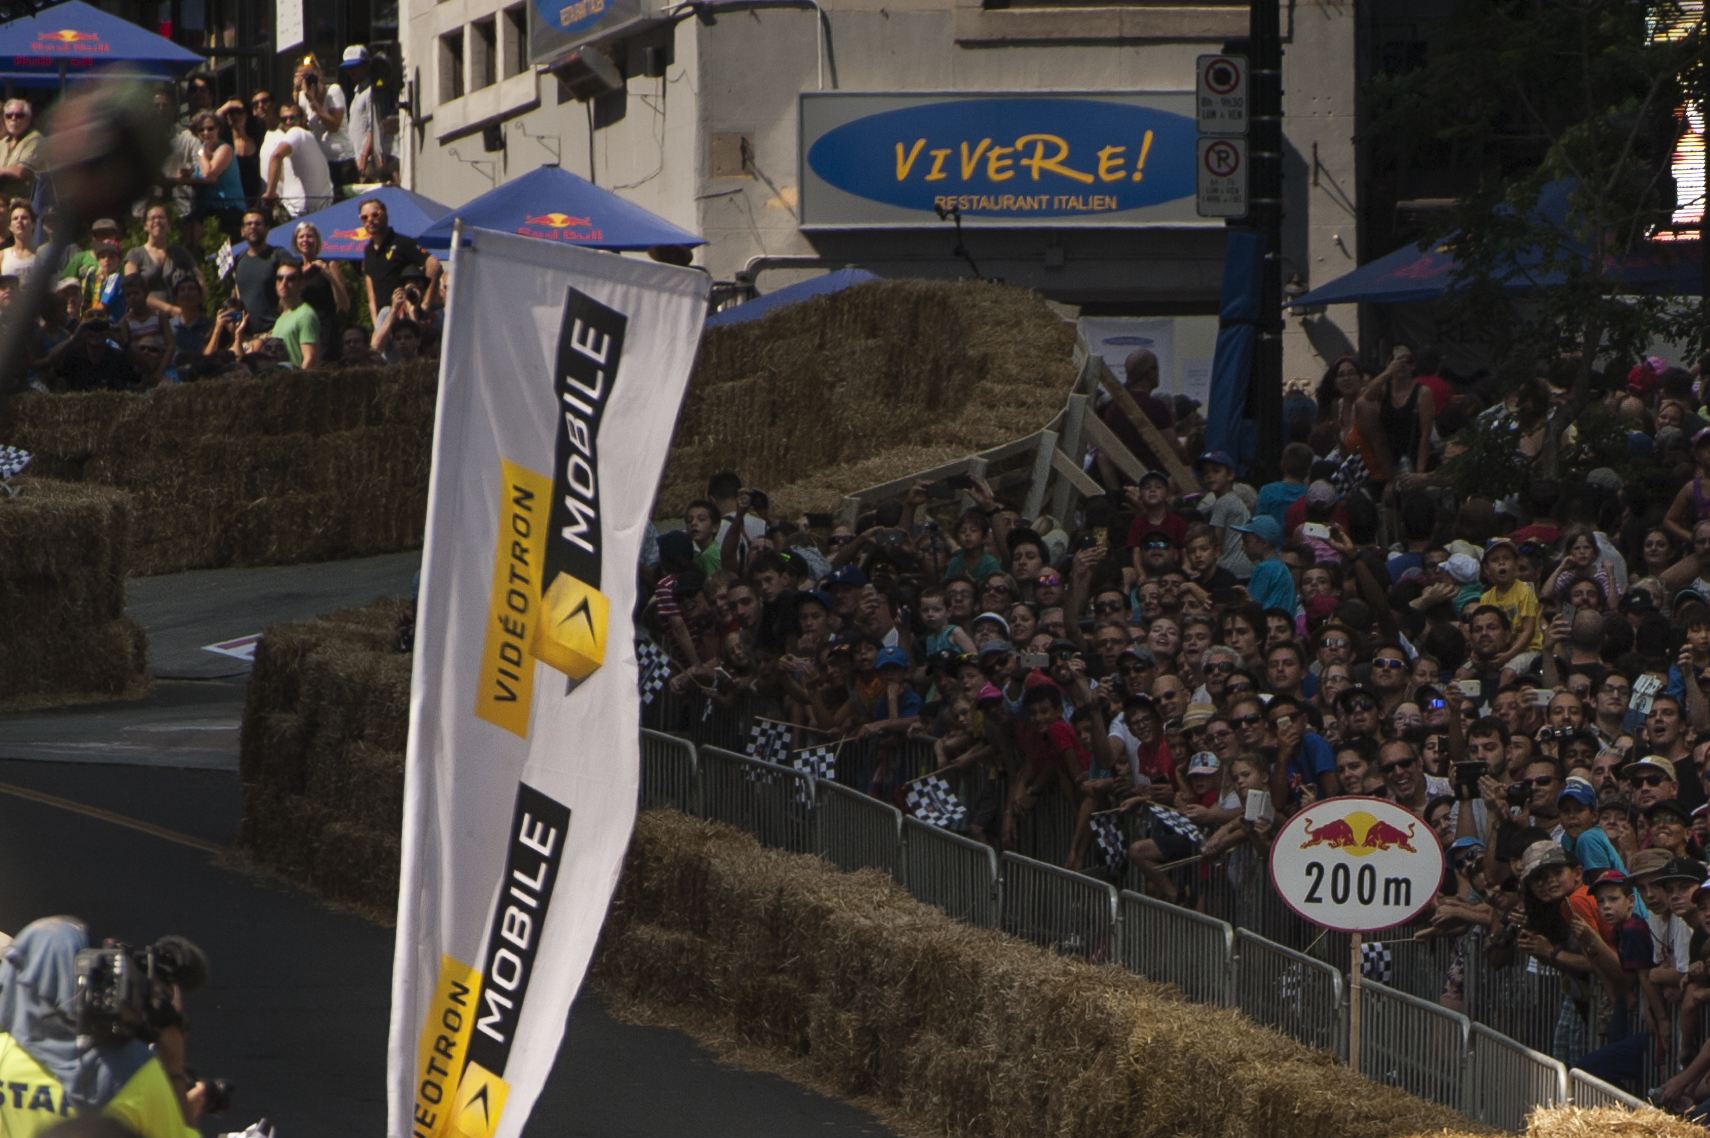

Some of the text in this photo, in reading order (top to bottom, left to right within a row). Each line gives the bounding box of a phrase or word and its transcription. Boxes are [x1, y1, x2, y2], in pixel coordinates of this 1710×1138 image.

[934, 195, 1118, 211] RESTAURANT ITALIEN
[562, 315, 613, 553] MOBILE
[493, 485, 535, 703] VIDÉOTRON
[476, 808, 556, 1042] MOBILE
[1304, 861, 1412, 906] 200m
